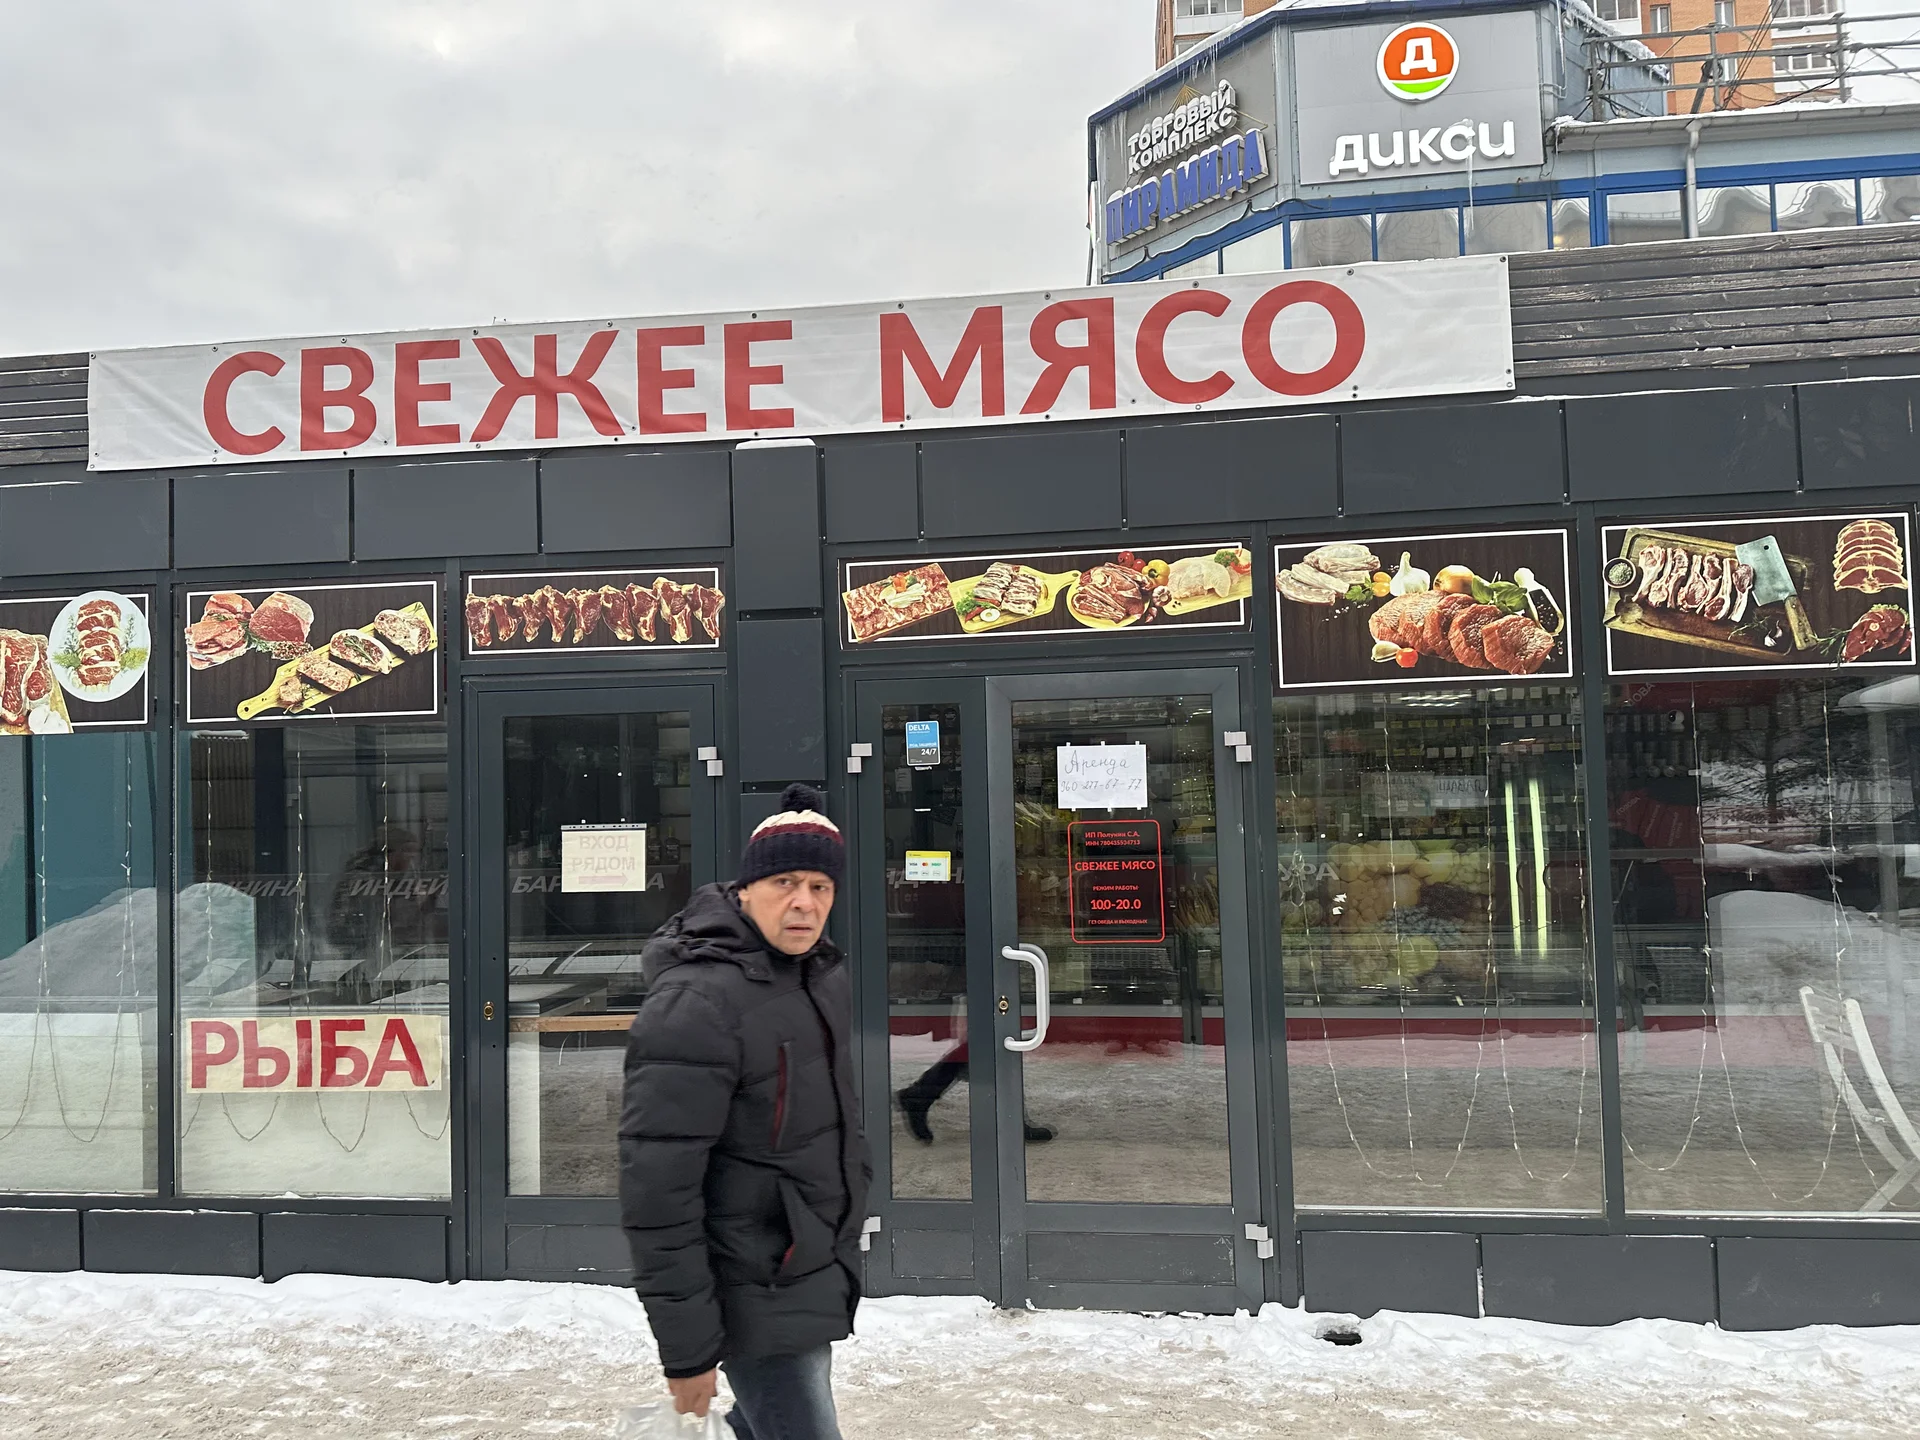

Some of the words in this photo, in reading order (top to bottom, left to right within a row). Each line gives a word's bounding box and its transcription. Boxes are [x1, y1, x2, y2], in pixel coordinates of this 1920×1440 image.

[1400, 37, 1437, 75] Д
[1128, 80, 1236, 153] ТОРГОВЫЙ
[1128, 107, 1238, 175] КОМПЛЕКС
[1106, 130, 1268, 246] ПИРАМИДА
[203, 319, 795, 456] СВЕЖЕЕ
[879, 279, 1366, 423] МЯСО
[921, 748, 937, 756] 24/7
[1064, 749, 1131, 776] Аренда
[579, 835, 629, 852] ВХОД
[572, 856, 635, 873] РЯДОМ
[1075, 861, 1119, 871] СВЕЖЕЕ
[1122, 860, 1156, 870] МЯСО
[190, 1018, 429, 1088] РЫБА
